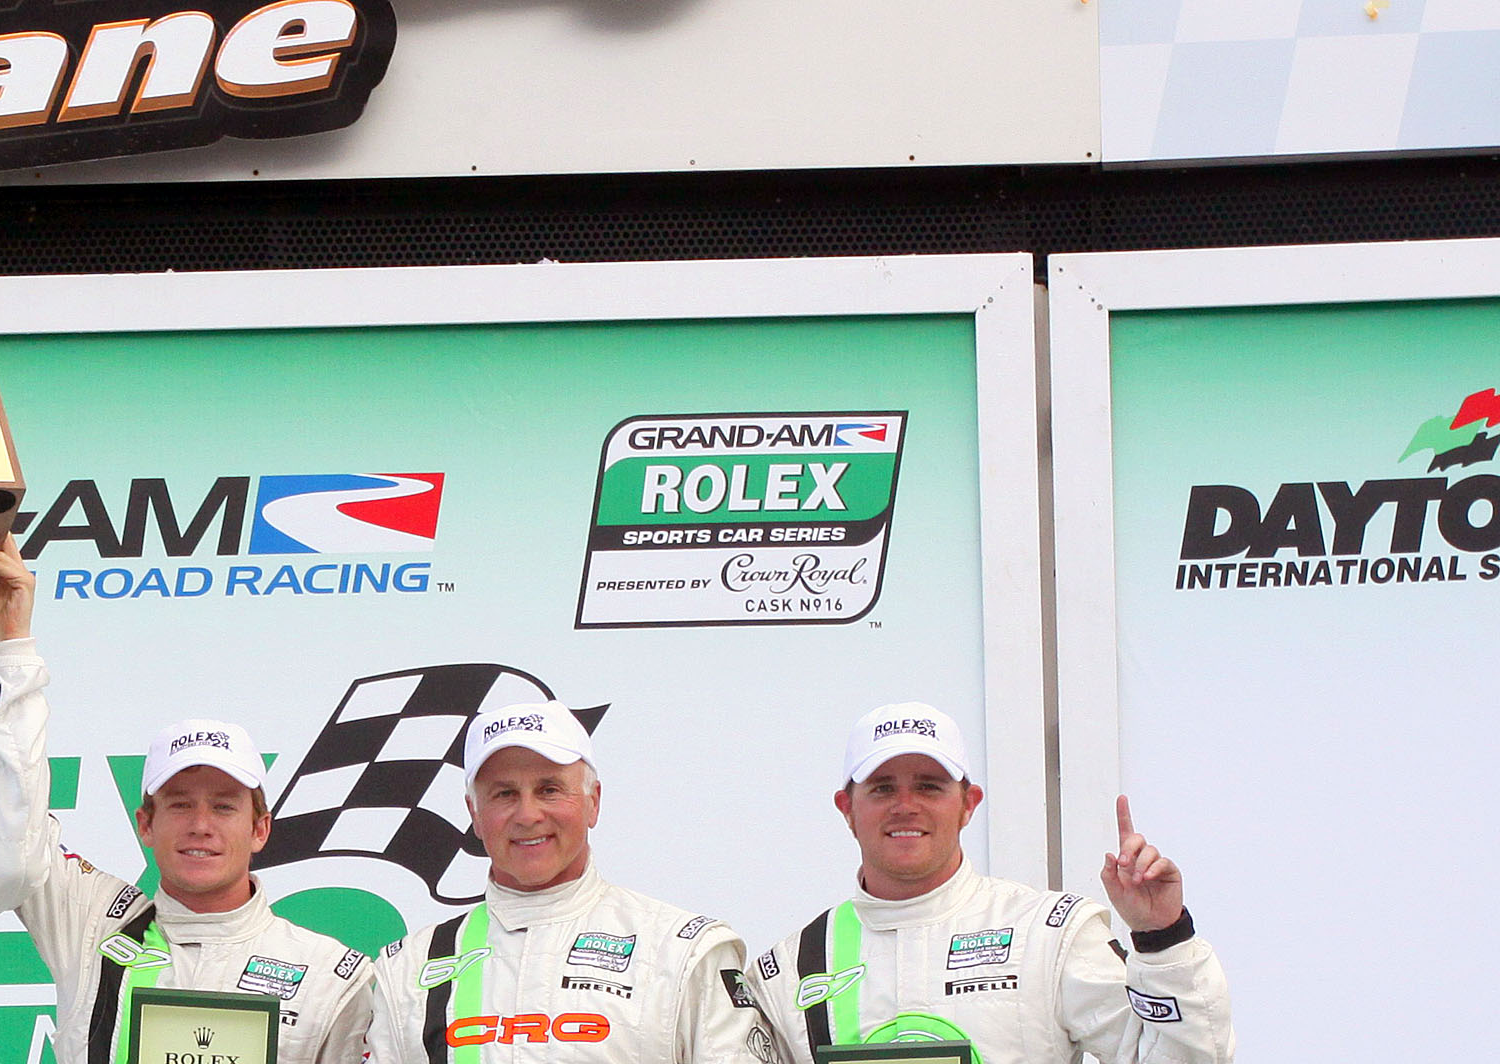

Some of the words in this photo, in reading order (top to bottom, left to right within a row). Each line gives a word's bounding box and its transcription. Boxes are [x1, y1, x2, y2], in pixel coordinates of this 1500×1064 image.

[640, 462, 849, 513] ROLEX
[622, 529, 711, 545] SPORTS
[717, 528, 765, 543] CAR
[769, 526, 847, 542] SERIES
[54, 567, 214, 600] ROAD
[225, 562, 432, 596] RACING
[720, 553, 790, 592] Crown
[768, 553, 867, 595] Royal
[1175, 555, 1467, 590] INTERNATIONAL
[596, 580, 685, 591] PRESENTED
[690, 579, 712, 590] BY
[745, 599, 792, 612] CASK
[484, 717, 526, 738] ROLEX
[524, 722, 543, 732] 24
[875, 719, 920, 737] ROLEX
[171, 732, 215, 751] ROLEX
[583, 940, 625, 954] ROLEX
[960, 937, 1002, 949] ROLEX
[255, 964, 296, 981] ROLEX
[561, 976, 633, 999] PIRELLI
[798, 966, 865, 1007] 67
[945, 975, 1018, 996] PIRELLI
[445, 1014, 610, 1047] CRG
